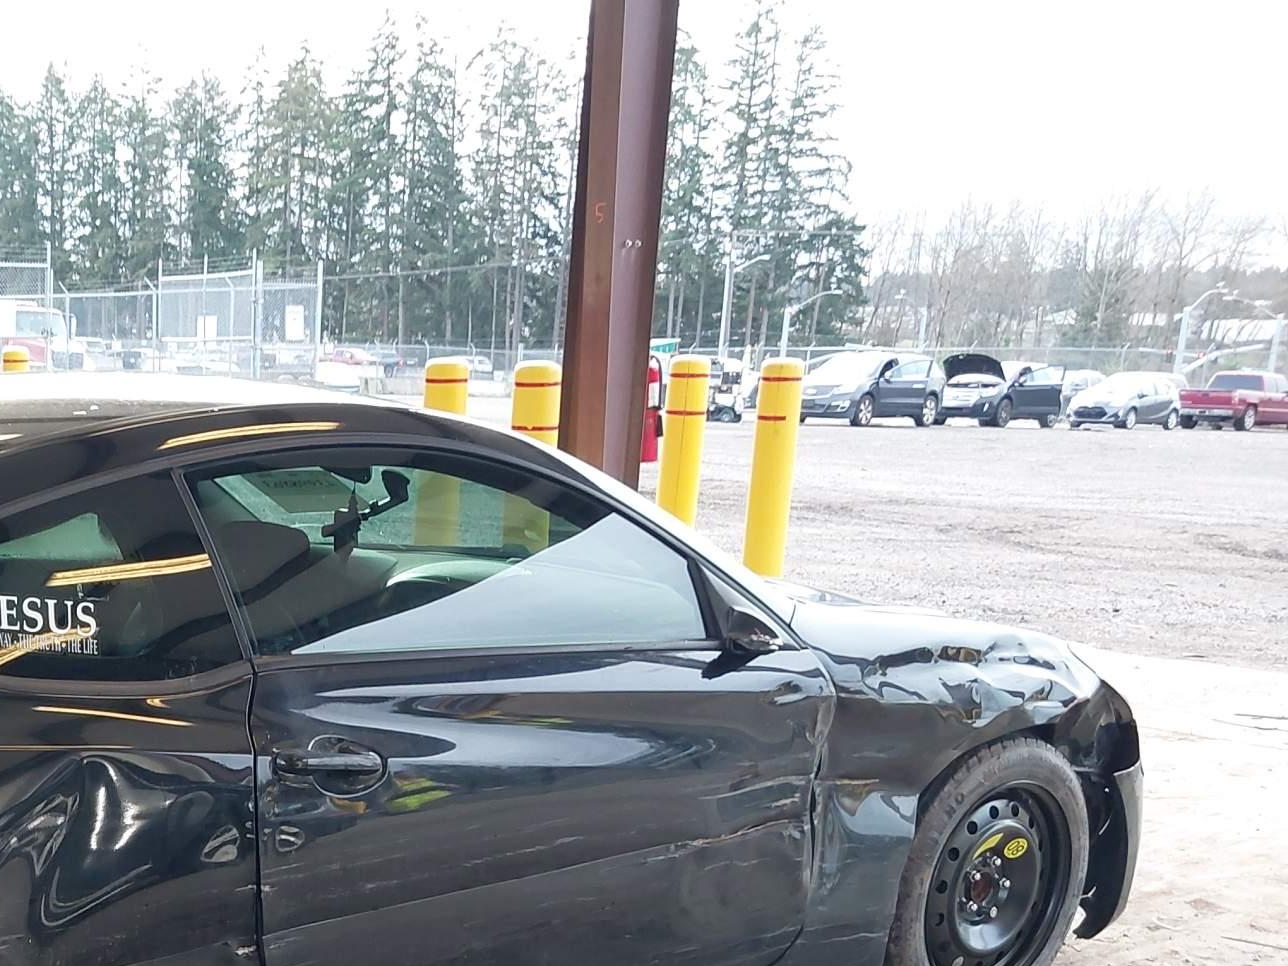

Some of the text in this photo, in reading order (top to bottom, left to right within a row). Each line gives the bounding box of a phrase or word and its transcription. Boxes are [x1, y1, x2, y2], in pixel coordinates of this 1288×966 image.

[17, 633, 32, 649] THE
[67, 638, 82, 653] THE
[83, 638, 98, 655] LIFE
